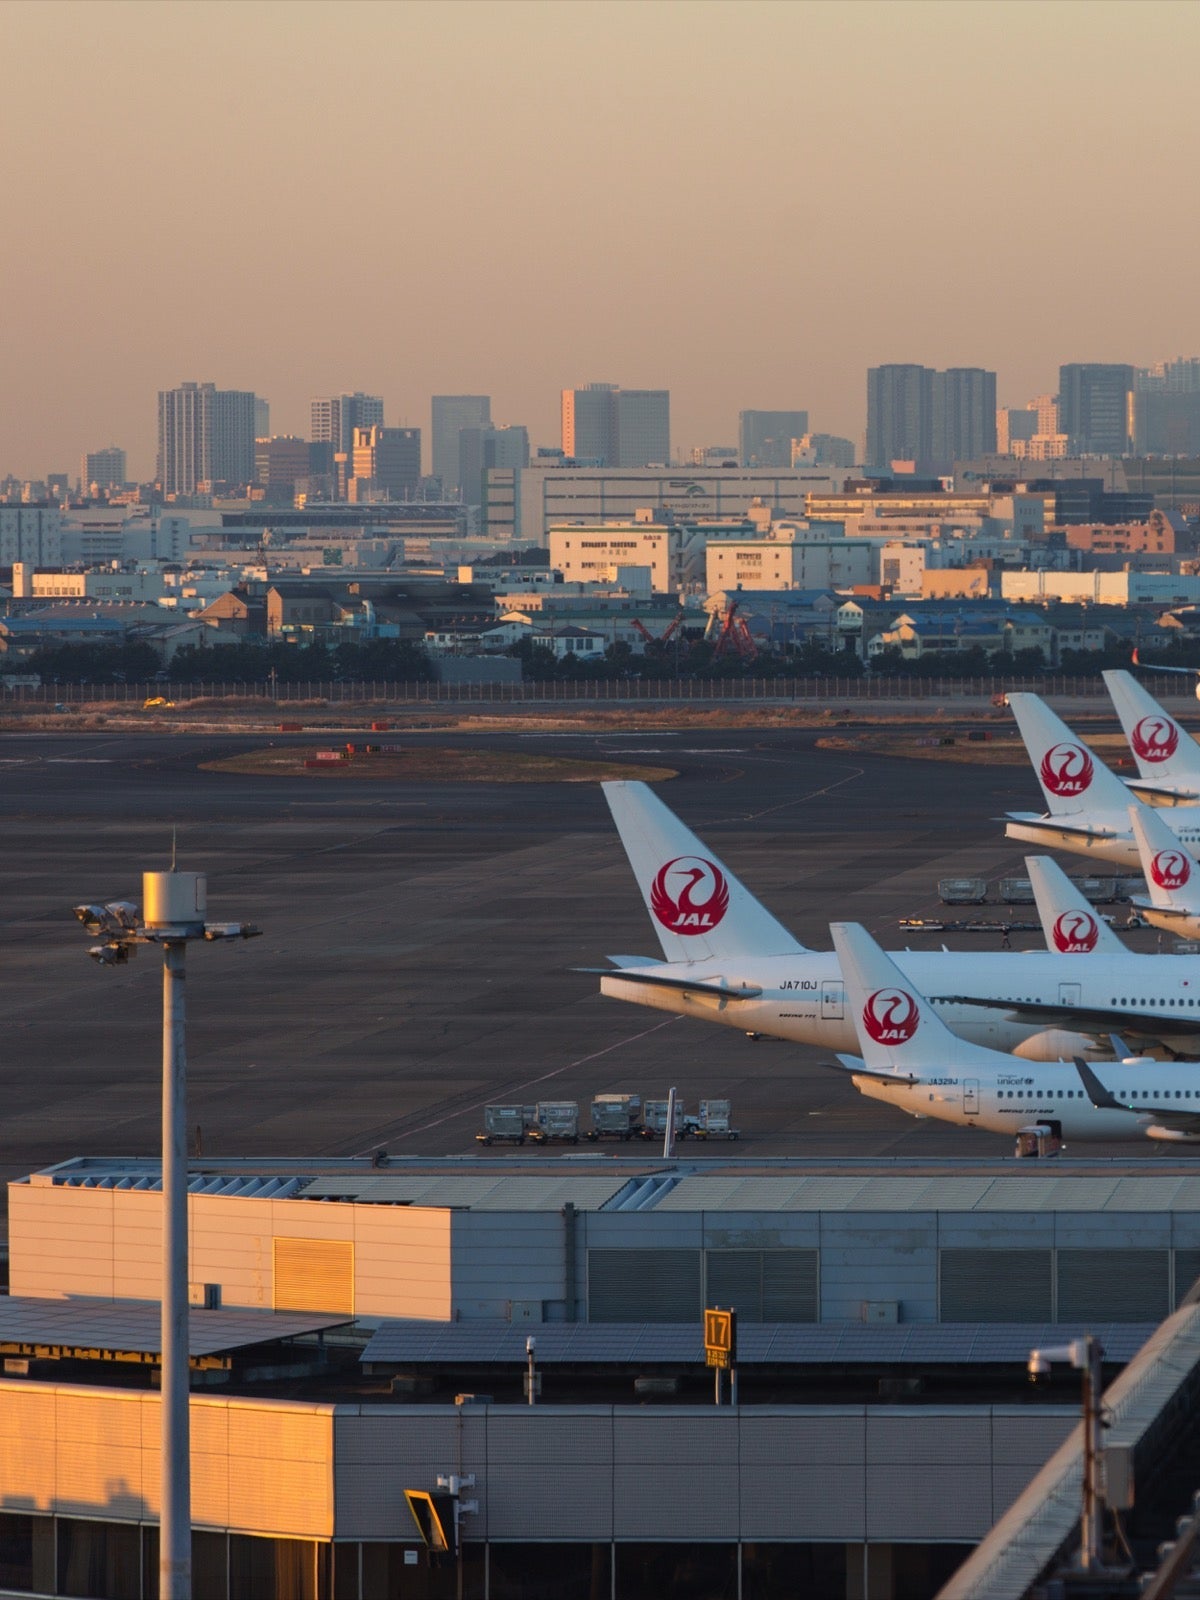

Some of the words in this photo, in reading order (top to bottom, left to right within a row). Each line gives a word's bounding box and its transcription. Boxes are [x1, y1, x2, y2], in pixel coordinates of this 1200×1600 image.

[1144, 749, 1170, 757] JAL
[1055, 782, 1084, 790] JAL
[671, 913, 715, 925] JAL
[779, 981, 818, 990] JA710J
[877, 1030, 908, 1039] JAL
[710, 1317, 728, 1345] 17
